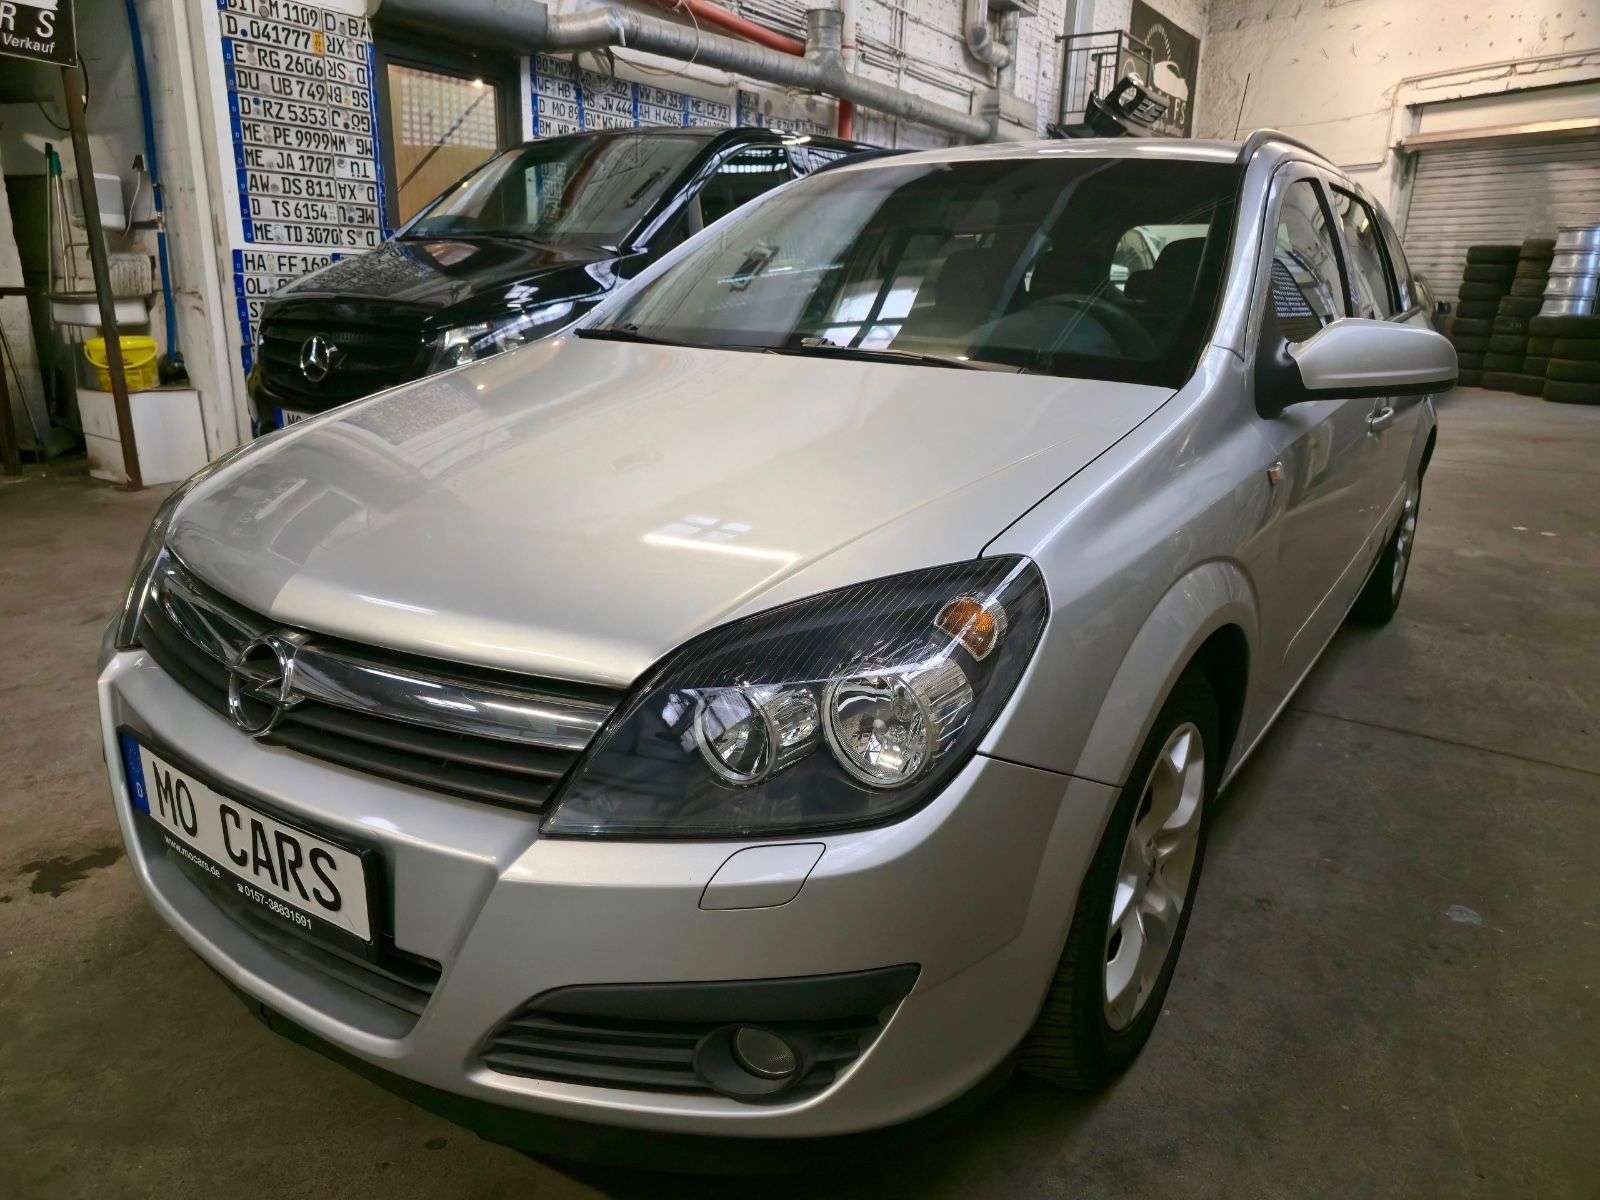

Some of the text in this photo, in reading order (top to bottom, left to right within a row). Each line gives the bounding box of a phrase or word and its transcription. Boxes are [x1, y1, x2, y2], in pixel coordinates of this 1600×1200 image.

[283, 3, 318, 27] 1109
[3, 32, 56, 55] Verkauf
[226, 15, 238, 35] D
[250, 20, 311, 49] 041777
[234, 43, 323, 77] E RG 2606
[237, 69, 325, 102] DU UB 749
[240, 96, 327, 126] D RZ 5353
[242, 121, 330, 150] ME PE 9999
[245, 147, 332, 175] ME JA 1707
[249, 173, 335, 198] AW DS 811
[251, 198, 261, 215] D
[272, 200, 291, 217] TS
[294, 202, 328, 221] 6154
[254, 223, 339, 245] ME TD 3070
[244, 253, 267, 271] HA
[278, 255, 298, 273] FF
[245, 277, 267, 295] OL
[152, 760, 342, 912] MO CARS
[163, 834, 221, 878] www.mocars.de
